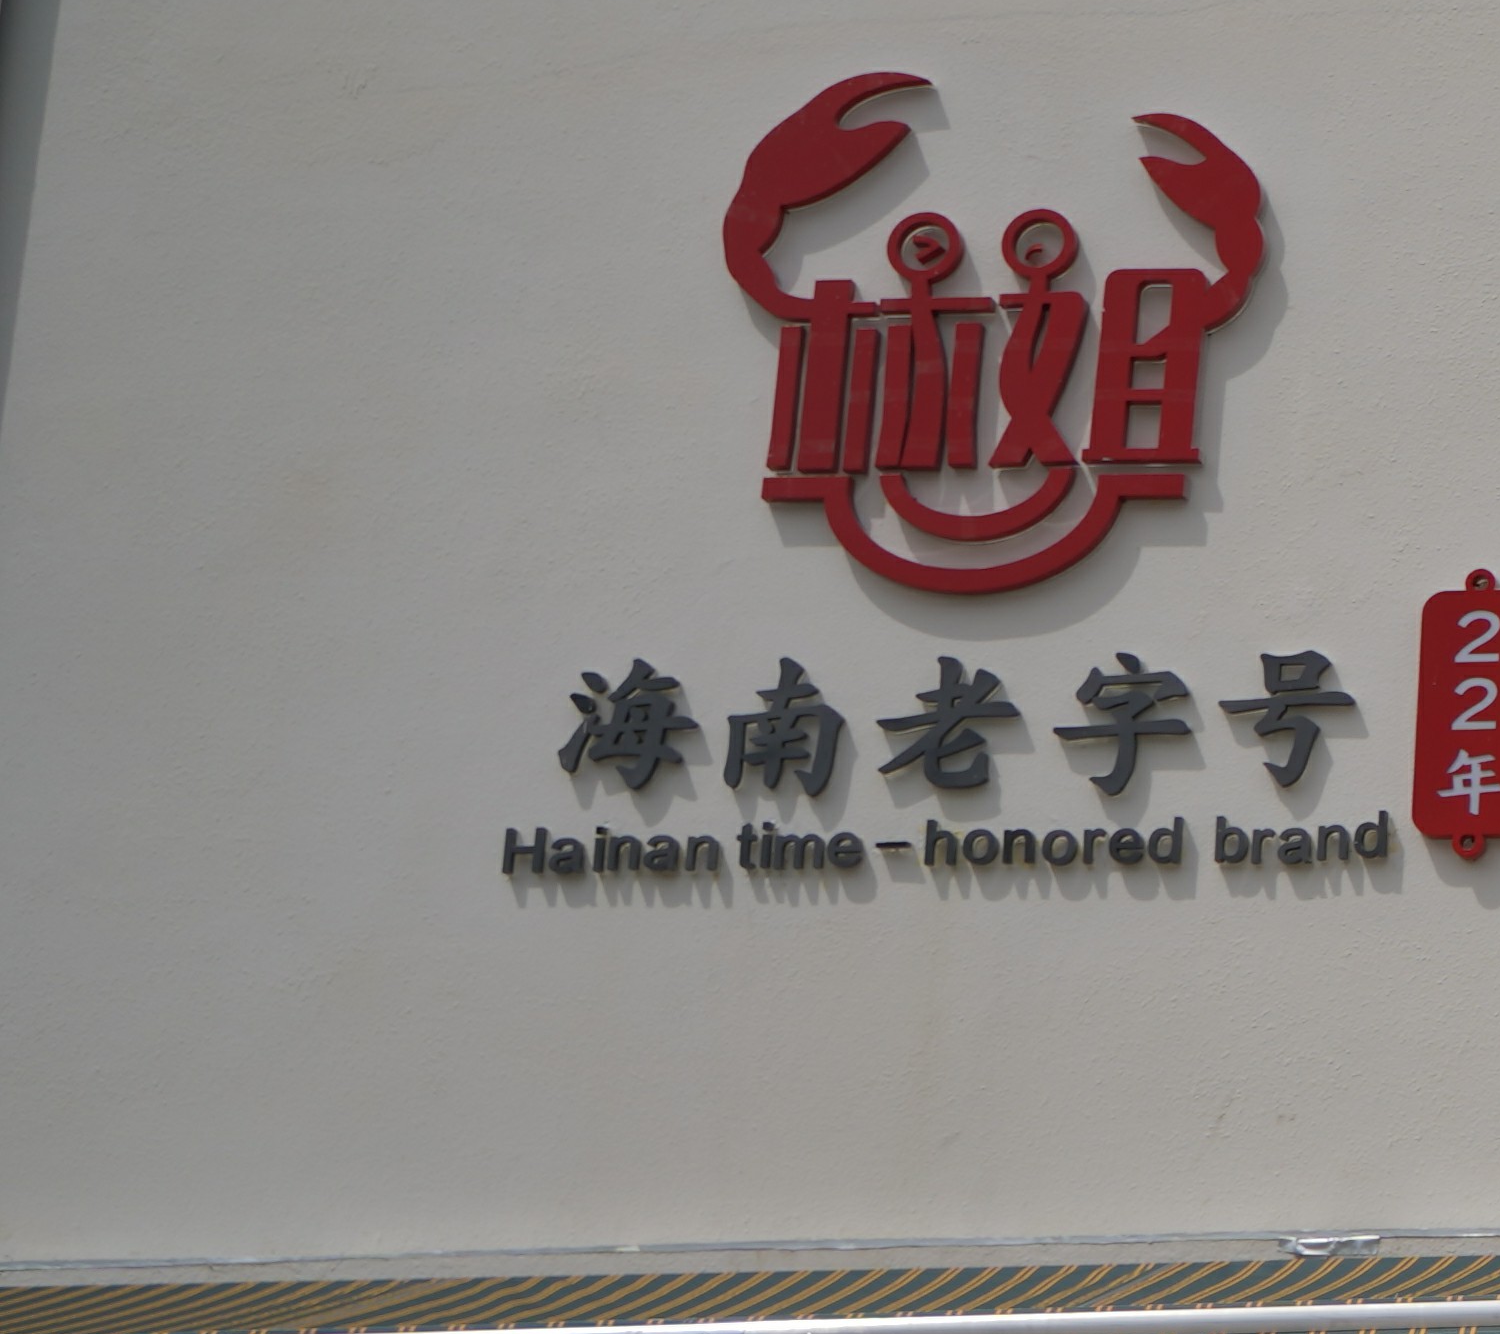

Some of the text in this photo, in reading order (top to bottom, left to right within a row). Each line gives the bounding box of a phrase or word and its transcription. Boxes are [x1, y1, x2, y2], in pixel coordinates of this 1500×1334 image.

[558, 650, 1358, 797] 海南老字号
[502, 827, 720, 875] Hainan
[1215, 811, 1391, 865] brand
